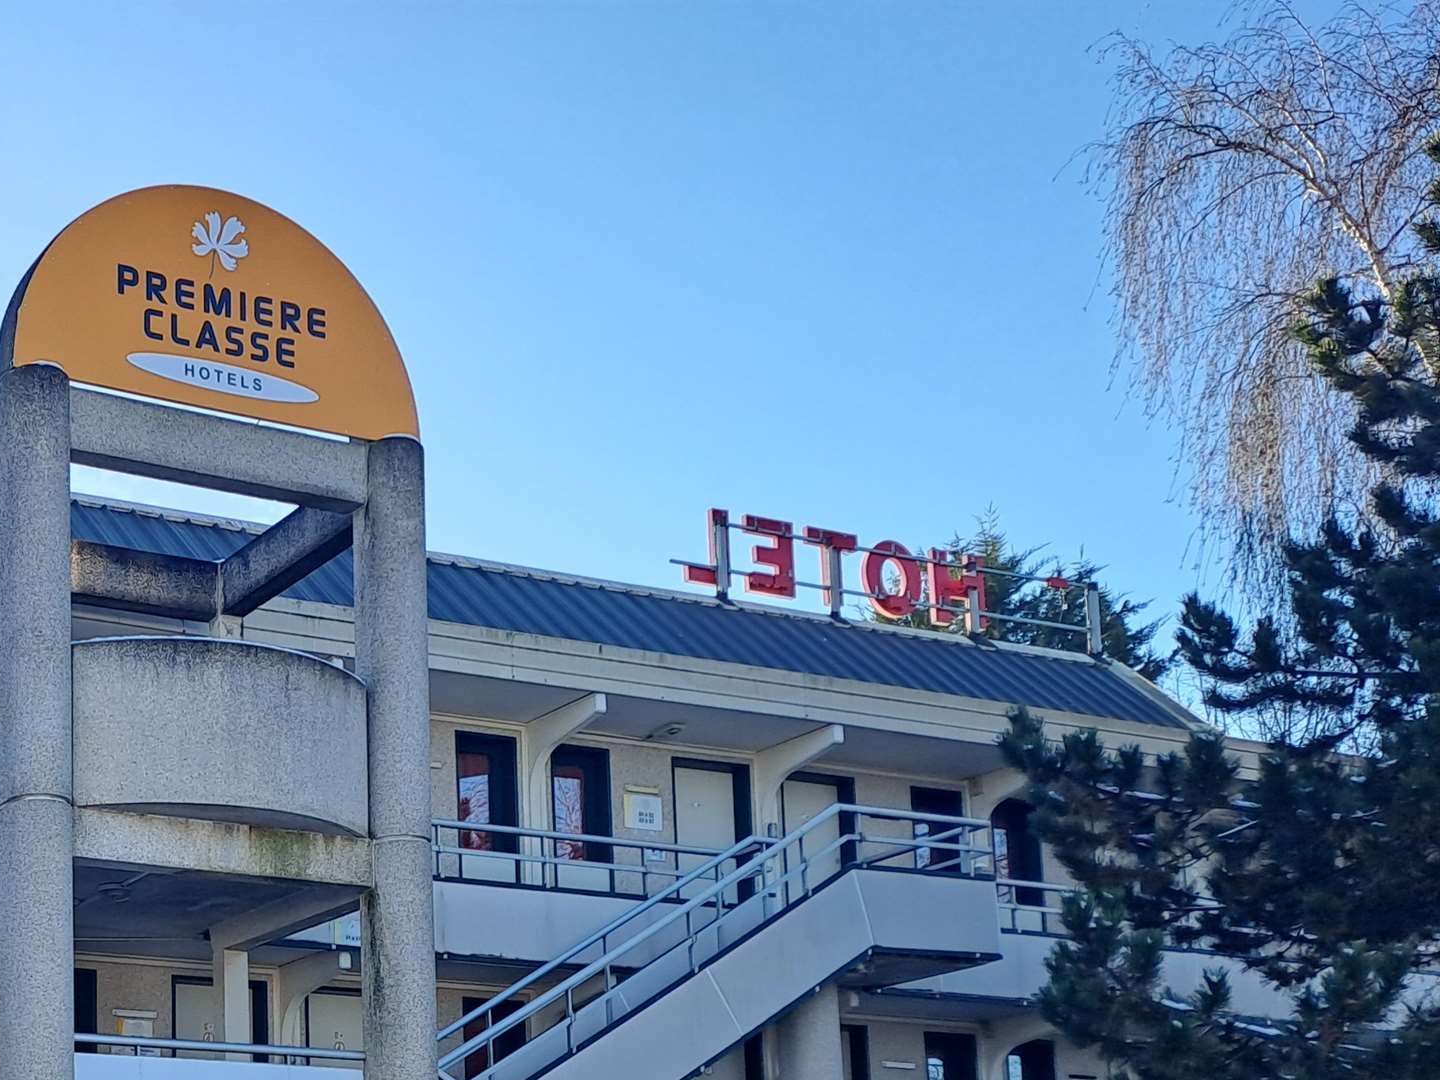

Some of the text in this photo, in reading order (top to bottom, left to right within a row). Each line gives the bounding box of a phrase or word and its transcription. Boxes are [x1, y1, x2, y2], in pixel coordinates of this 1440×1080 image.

[116, 263, 327, 339] PREMIERE
[143, 308, 296, 369] CLASSE
[183, 363, 263, 392] HOTELS
